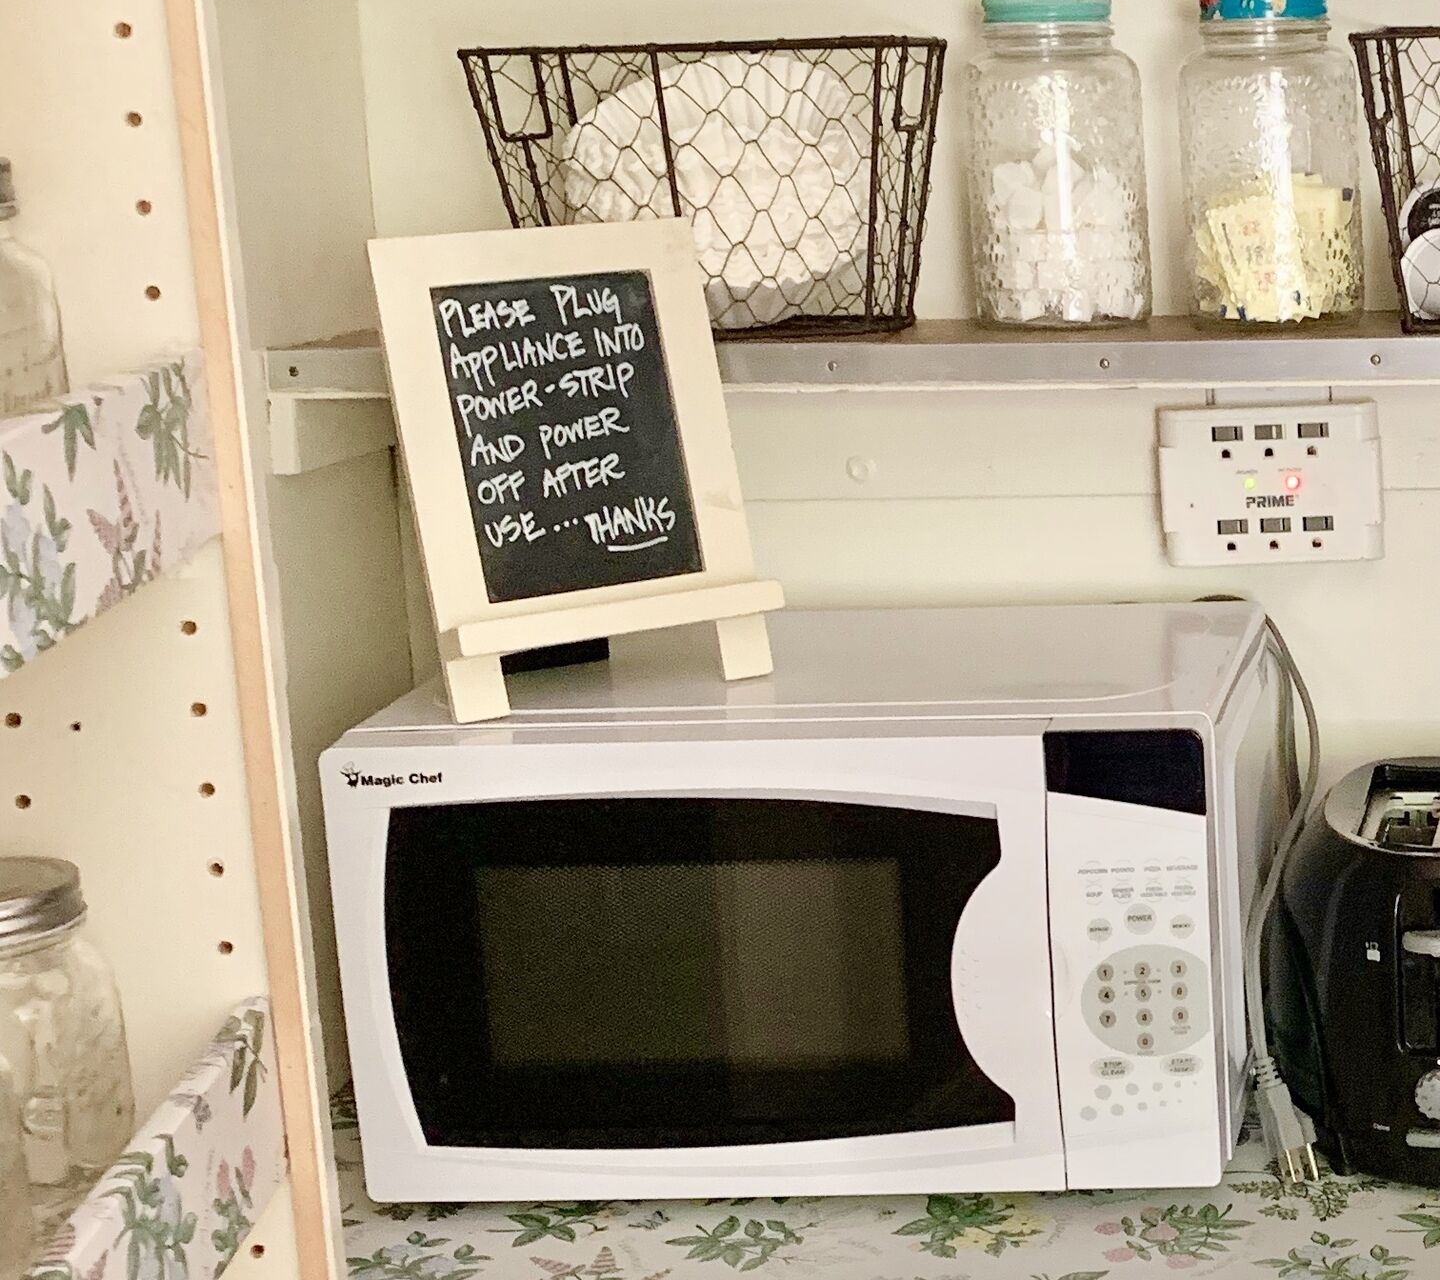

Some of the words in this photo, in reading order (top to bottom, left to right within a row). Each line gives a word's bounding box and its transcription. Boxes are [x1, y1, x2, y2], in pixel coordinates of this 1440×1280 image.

[438, 298, 537, 339] PLEASE
[549, 284, 623, 326] PLUG
[450, 331, 587, 392] APPLIANCE
[593, 322, 645, 358] INTO
[470, 433, 526, 467] AND
[538, 406, 631, 460] POWER
[477, 470, 526, 505] OFF
[542, 452, 626, 499] AFTER
[1245, 494, 1295, 509] PRIME
[583, 496, 676, 544] THANKS
[361, 775, 404, 788] Magic
[409, 772, 443, 784] Chef
[1127, 914, 1152, 922] POWER
